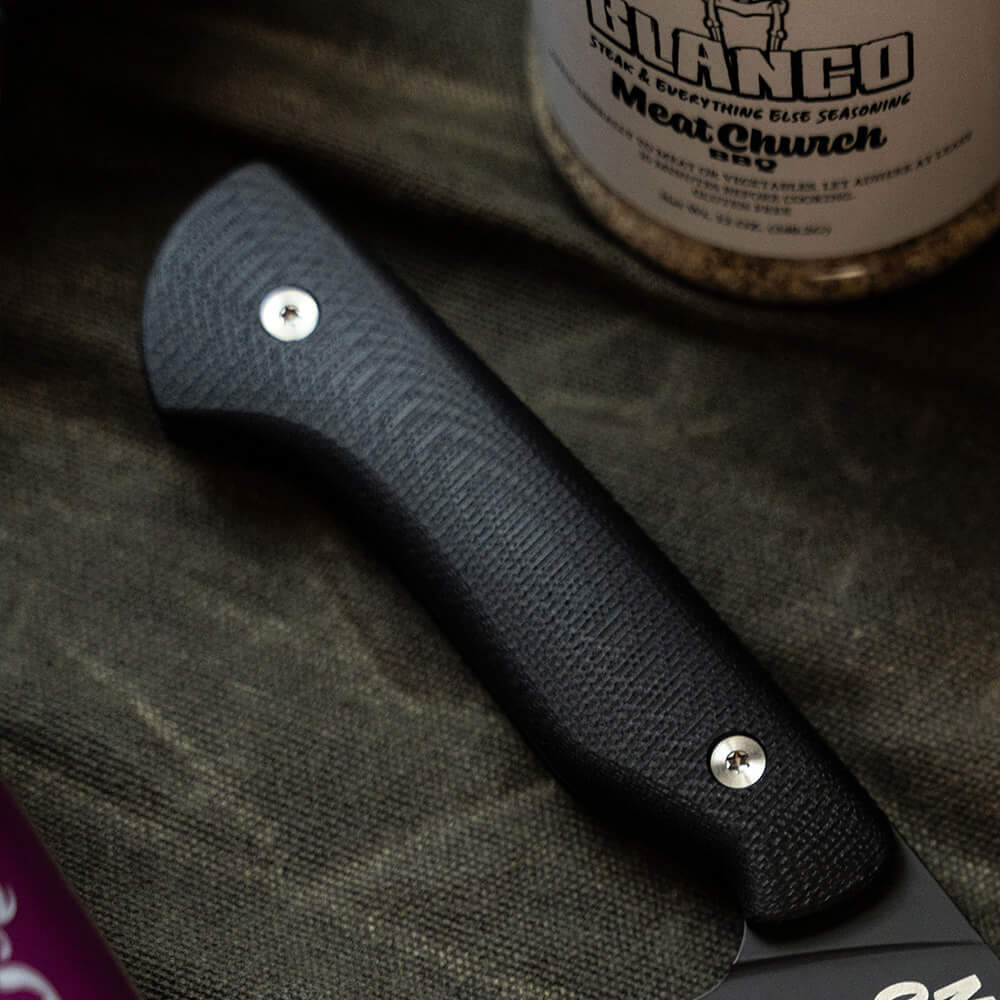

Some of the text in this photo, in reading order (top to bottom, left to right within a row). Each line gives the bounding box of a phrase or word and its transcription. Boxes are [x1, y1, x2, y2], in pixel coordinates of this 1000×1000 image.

[587, 0, 914, 101] BLANCO
[589, 34, 912, 125] STEAK & EVERYTHING ELSE SEASONING
[610, 70, 714, 144] Meat
[717, 123, 888, 157] Church
[708, 147, 778, 174] BBQ
